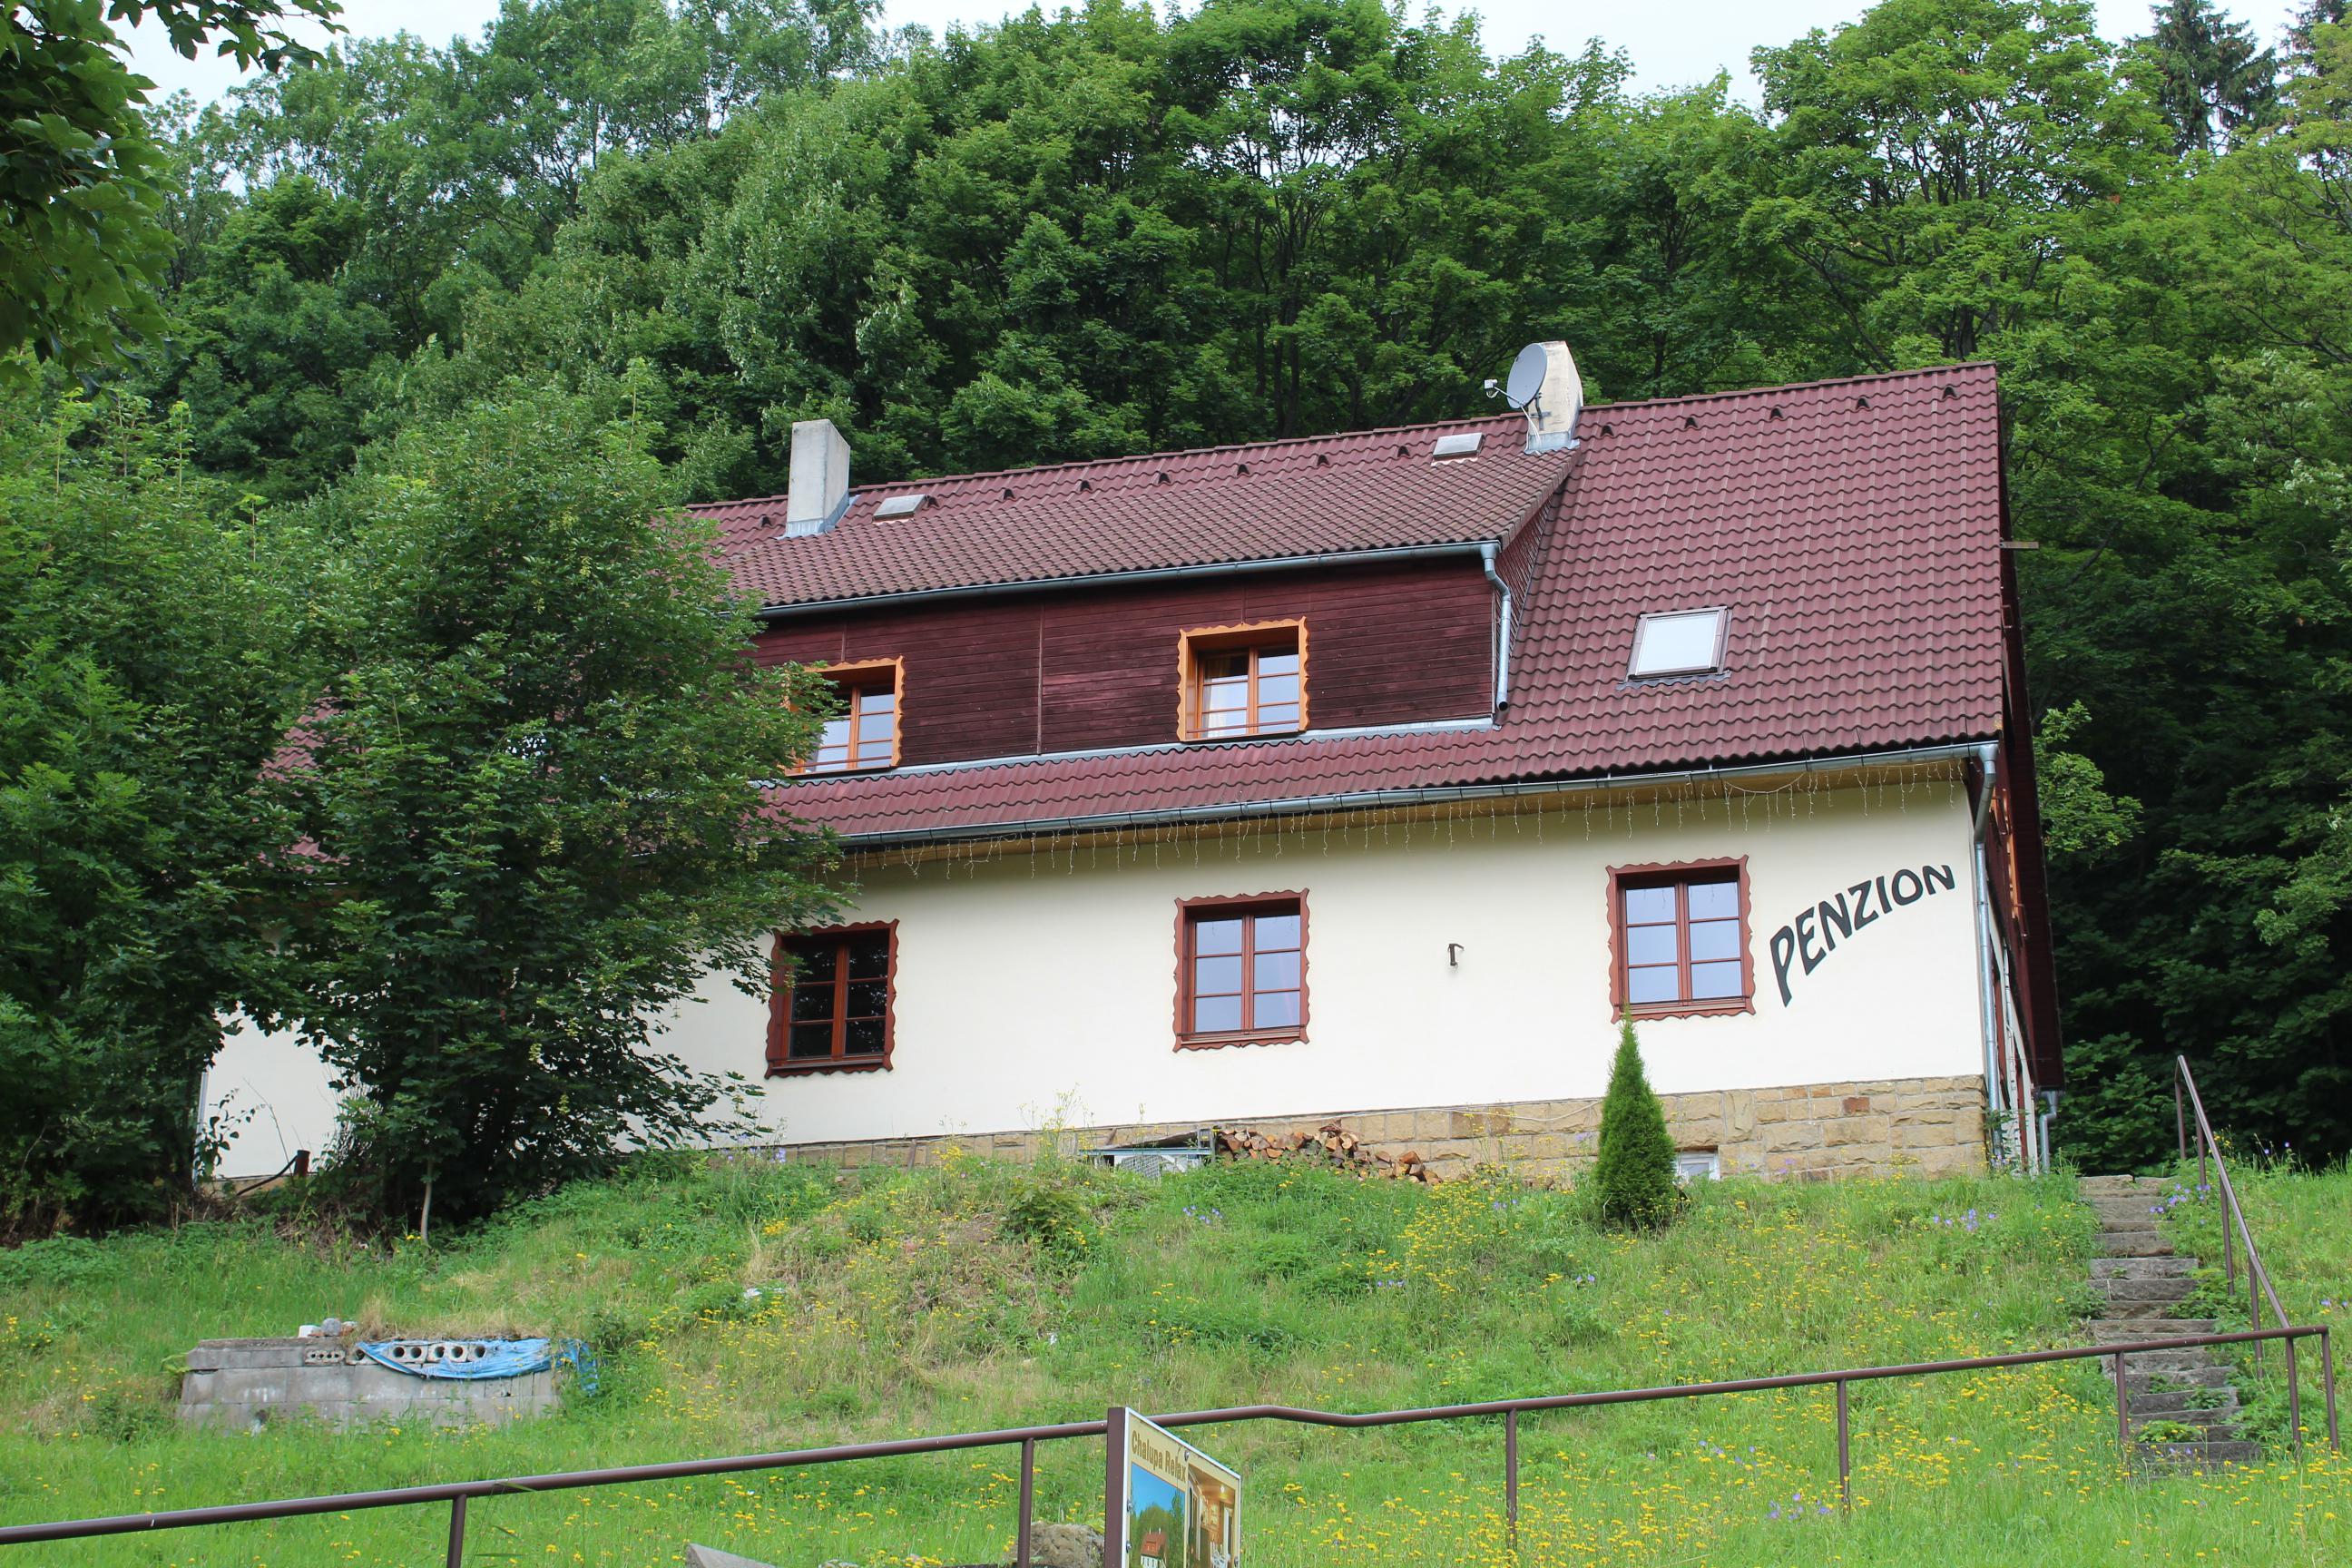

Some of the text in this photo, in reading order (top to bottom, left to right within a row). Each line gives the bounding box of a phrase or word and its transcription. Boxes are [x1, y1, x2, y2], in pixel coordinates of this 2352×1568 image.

[1769, 865, 1955, 1008] PENZION
[1132, 1430, 1186, 1483] Chalupa Relax
